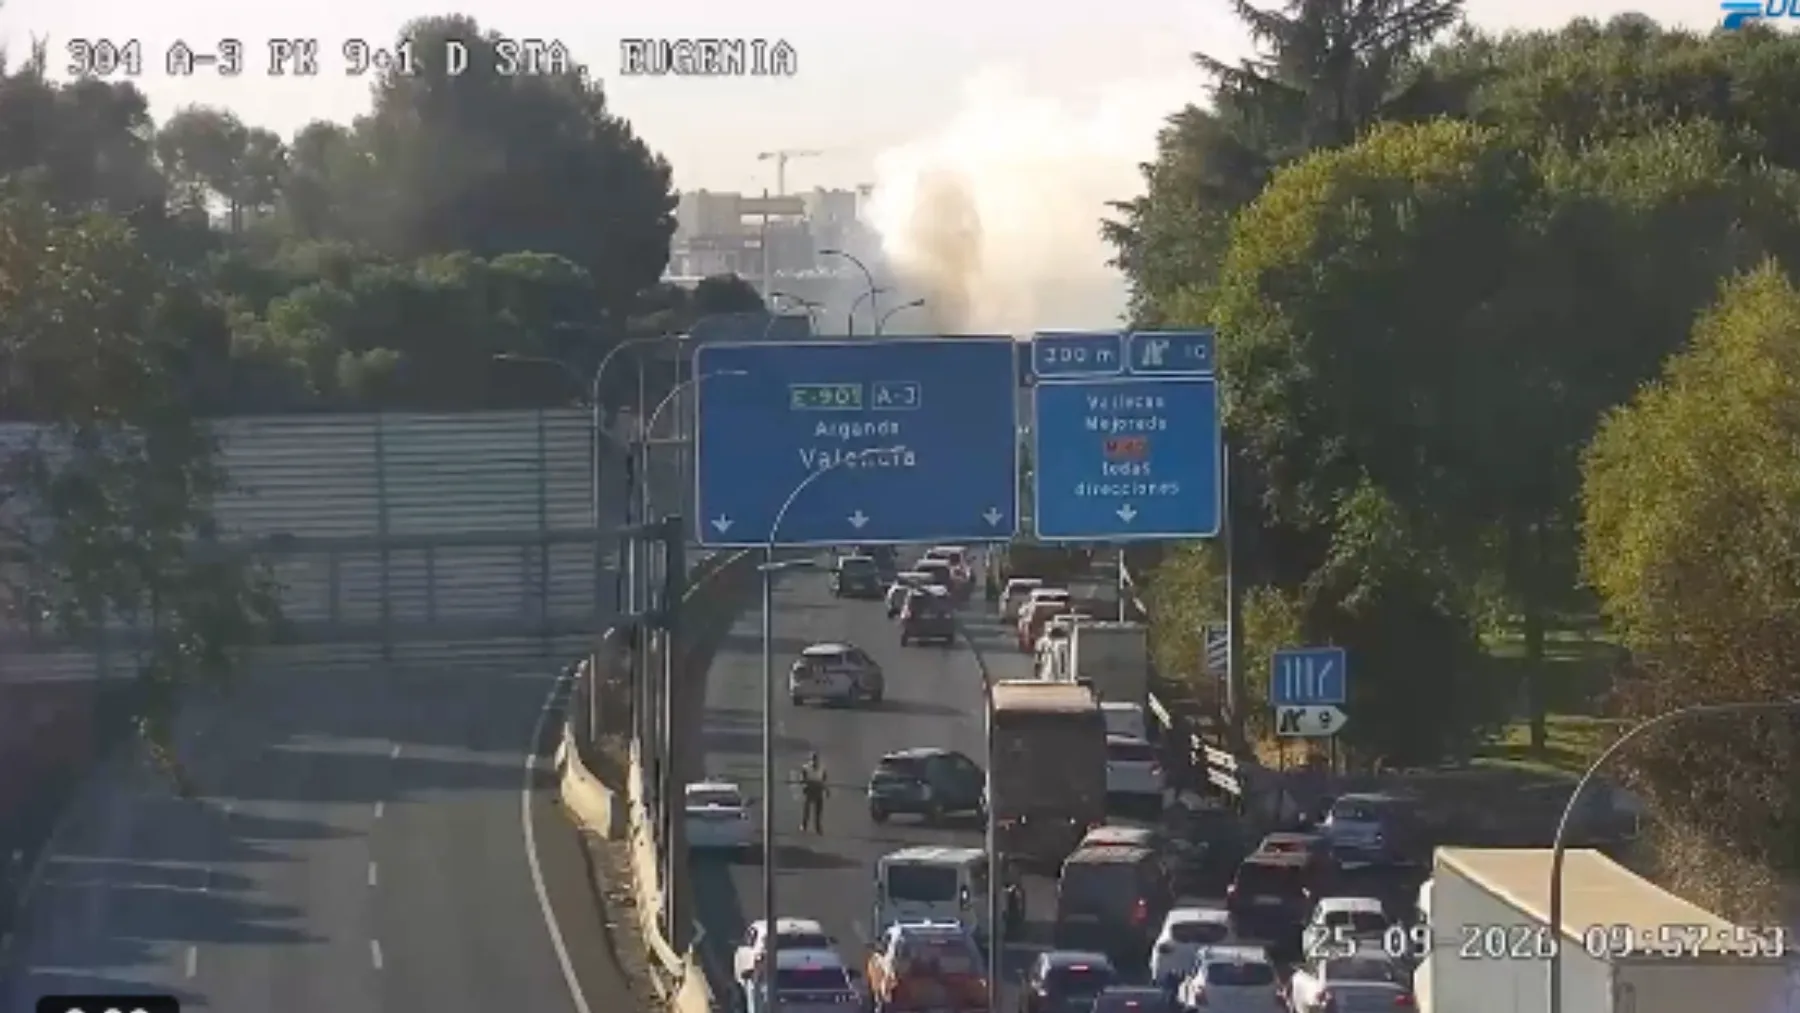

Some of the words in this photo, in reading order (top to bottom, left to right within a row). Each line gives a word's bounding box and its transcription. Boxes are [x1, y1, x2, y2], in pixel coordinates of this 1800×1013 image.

[793, 388, 861, 406] E-901
[877, 386, 915, 405] A-3
[814, 420, 900, 441] Arganda
[1318, 710, 1332, 730] 9
